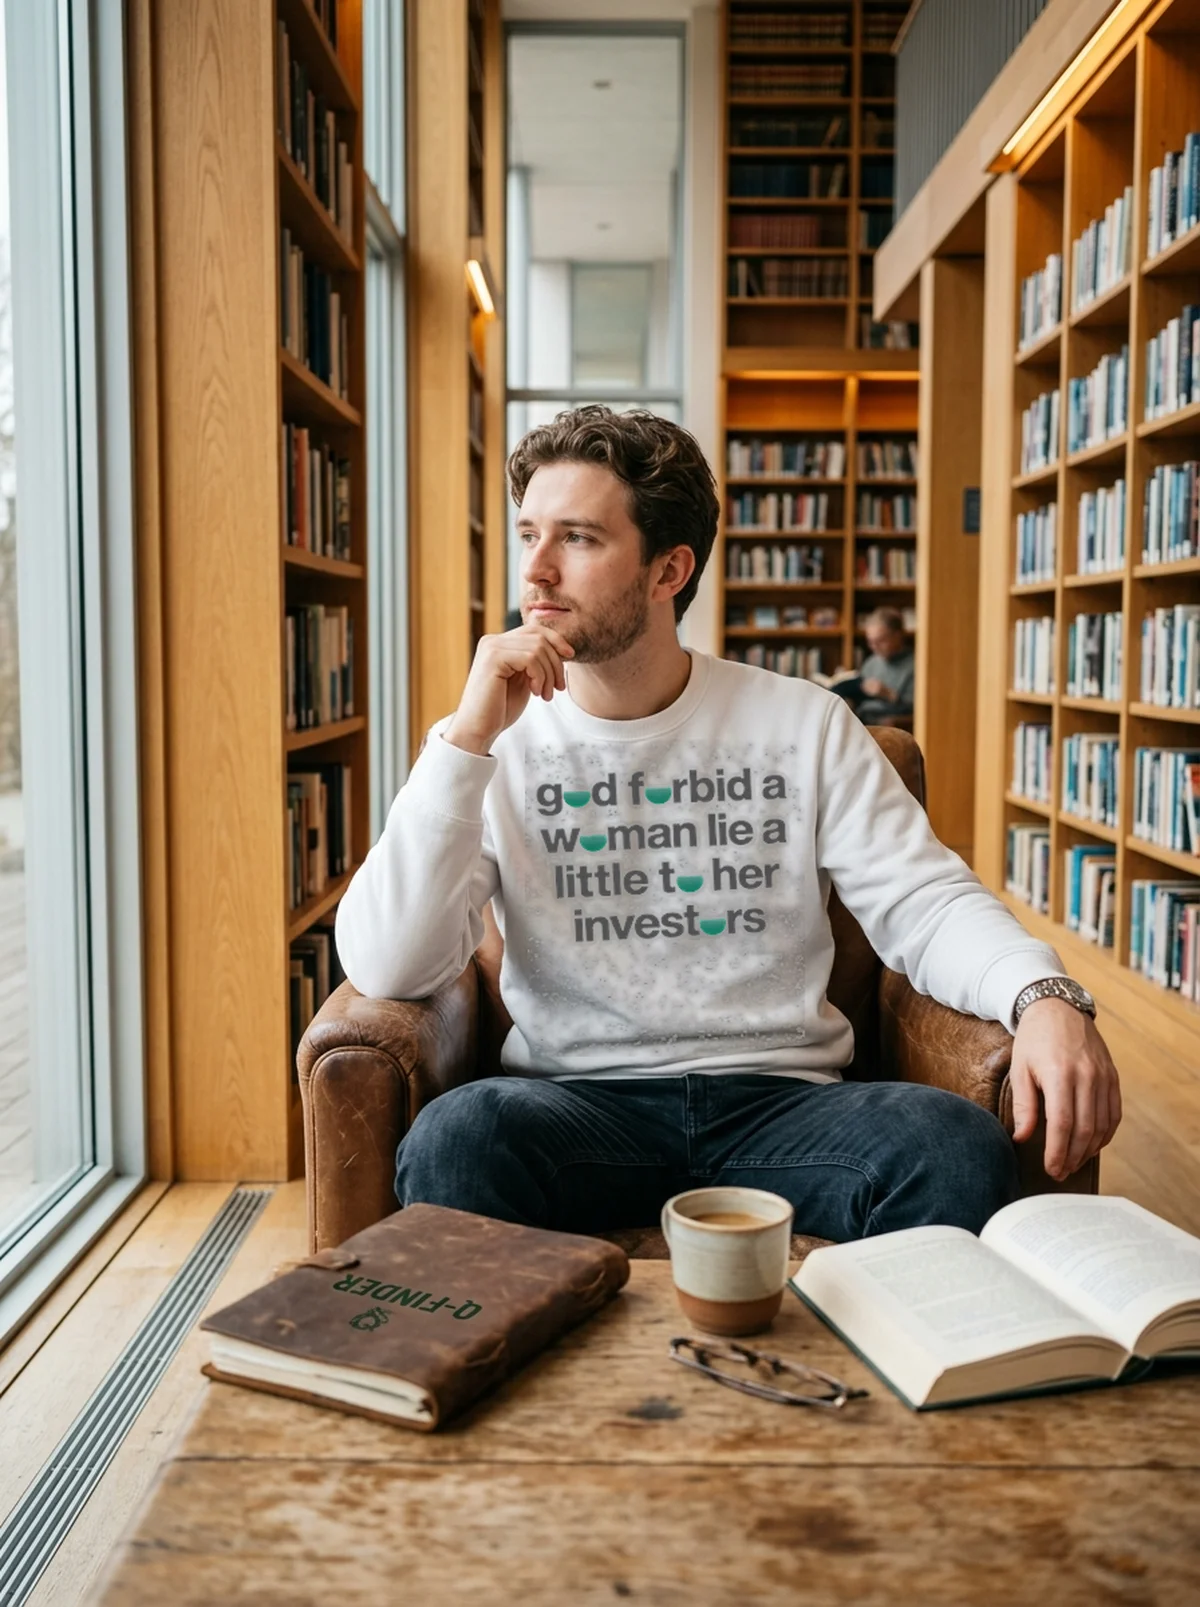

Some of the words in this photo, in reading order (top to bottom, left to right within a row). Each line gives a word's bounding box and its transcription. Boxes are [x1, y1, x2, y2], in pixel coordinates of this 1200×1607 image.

[762, 774, 787, 800] a
[707, 813, 754, 846] lie
[762, 817, 787, 845] a
[555, 861, 649, 899] little
[712, 857, 780, 891] her
[333, 1274, 482, 1320] Q-FINDER
